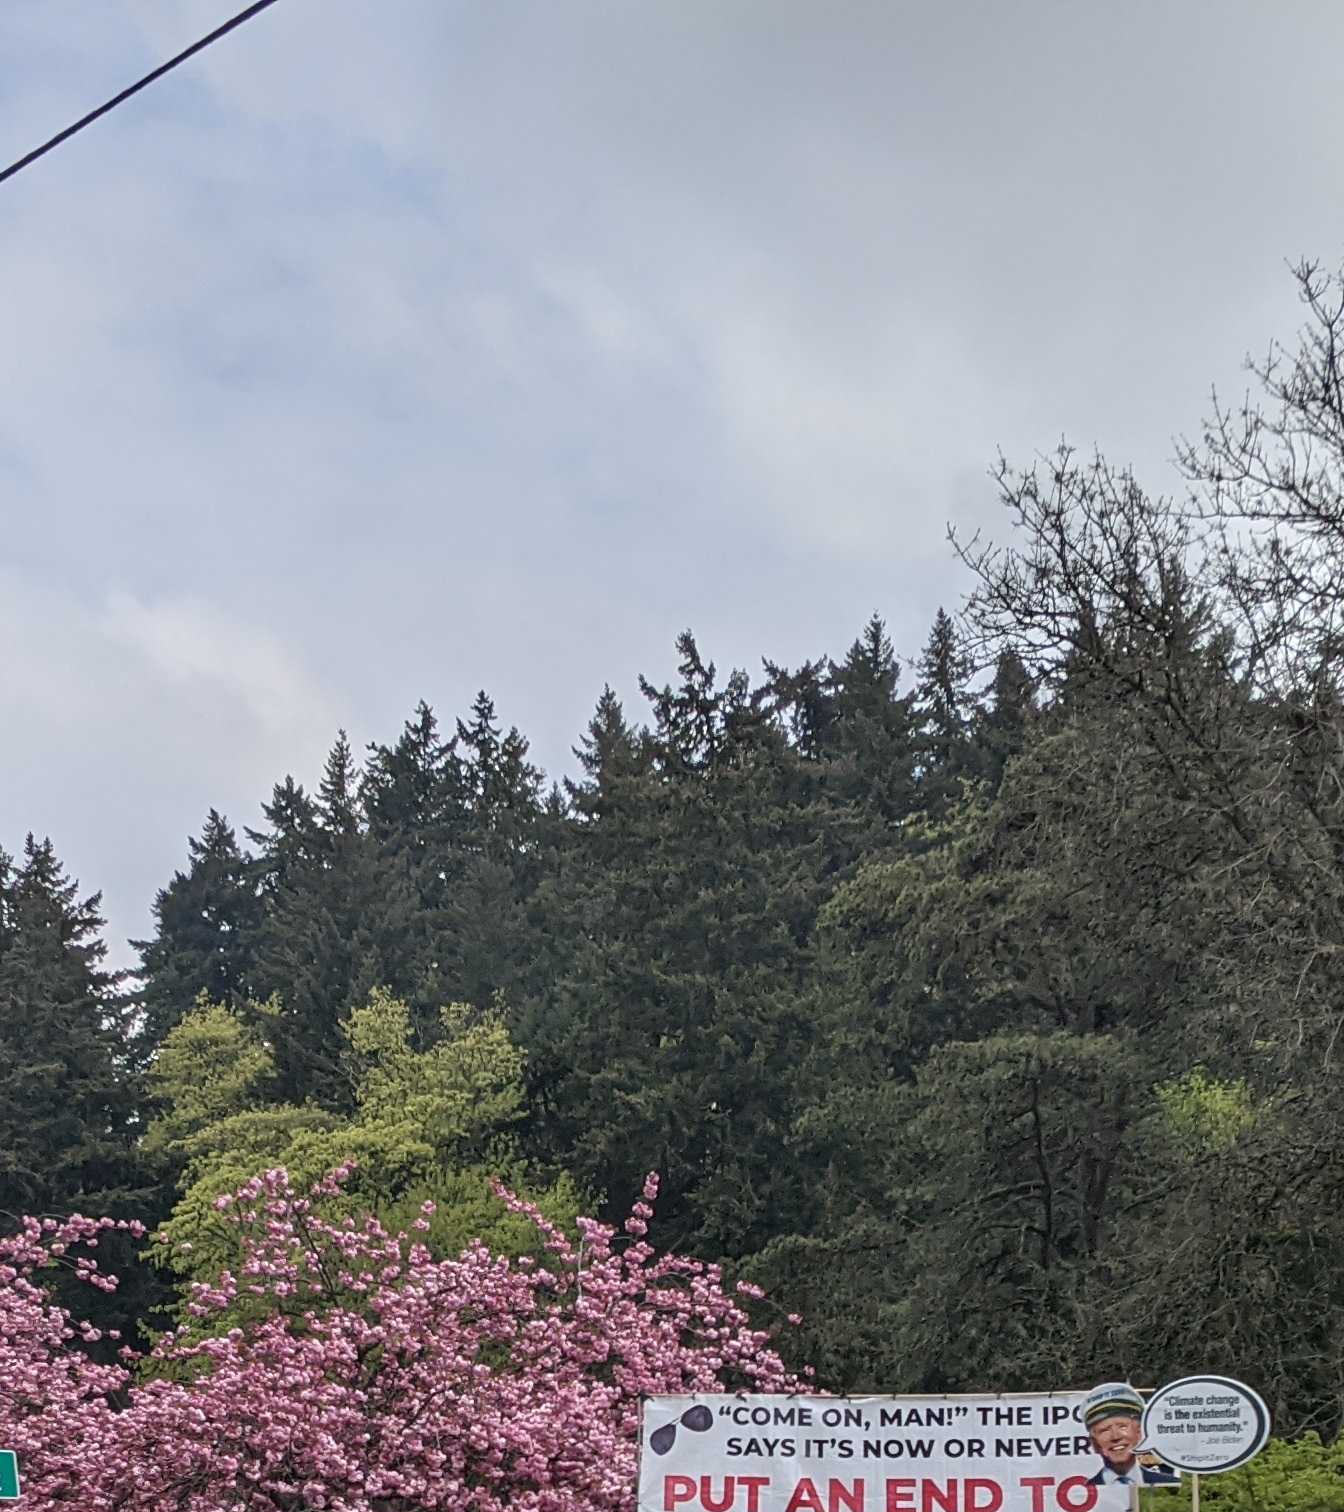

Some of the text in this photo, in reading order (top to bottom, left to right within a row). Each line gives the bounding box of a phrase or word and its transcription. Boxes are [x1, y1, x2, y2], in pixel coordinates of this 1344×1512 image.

[821, 1408, 871, 1431] ON,
[976, 1406, 1032, 1427] THE
[1164, 1409, 1173, 1420] is
[1174, 1409, 1190, 1420] the
[1157, 1423, 1184, 1434] threat
[1186, 1423, 1196, 1433] to
[726, 1435, 1092, 1459] SAYS IT'S NOW OR NEVER
